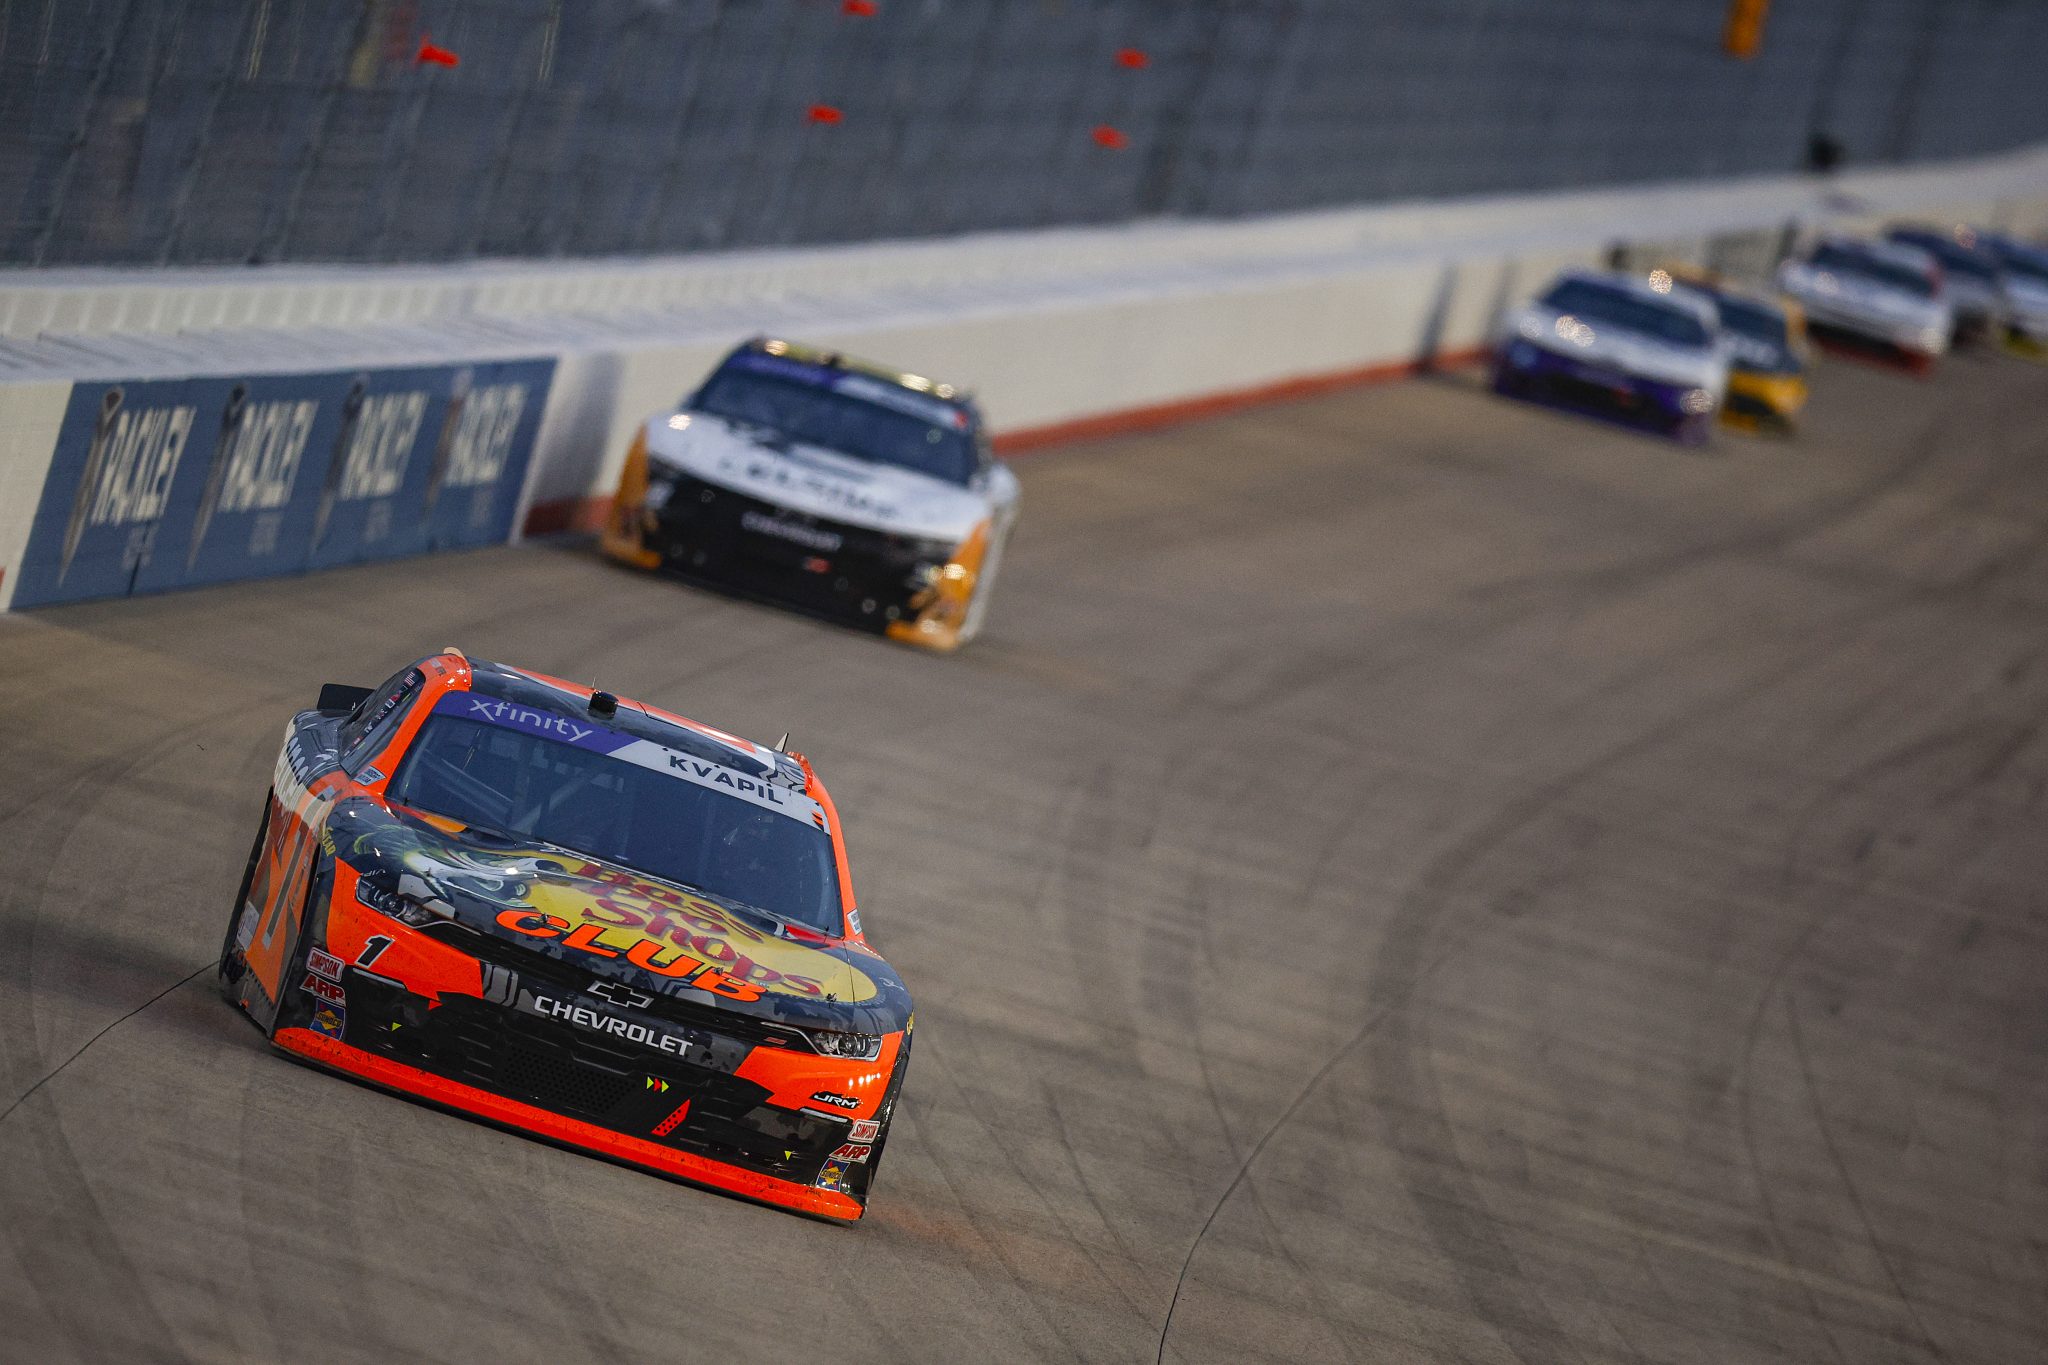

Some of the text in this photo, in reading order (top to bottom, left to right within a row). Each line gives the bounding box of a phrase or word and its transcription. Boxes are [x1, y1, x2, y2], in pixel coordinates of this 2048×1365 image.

[91, 405, 197, 526] RACKLEY
[470, 699, 593, 742] xfinity
[669, 754, 784, 805] KVAPIL
[571, 863, 764, 943] Bass
[577, 883, 730, 935] Pro
[310, 951, 341, 979] SIMPSON
[354, 934, 395, 968] 1
[495, 909, 770, 1002] CLUB
[581, 899, 824, 996] Shops
[302, 973, 346, 1002] ARP
[317, 1011, 342, 1028] SUNOCO
[534, 995, 693, 1056] CHEVROLET
[813, 1094, 857, 1109] JRM
[833, 1144, 870, 1159] ARP
